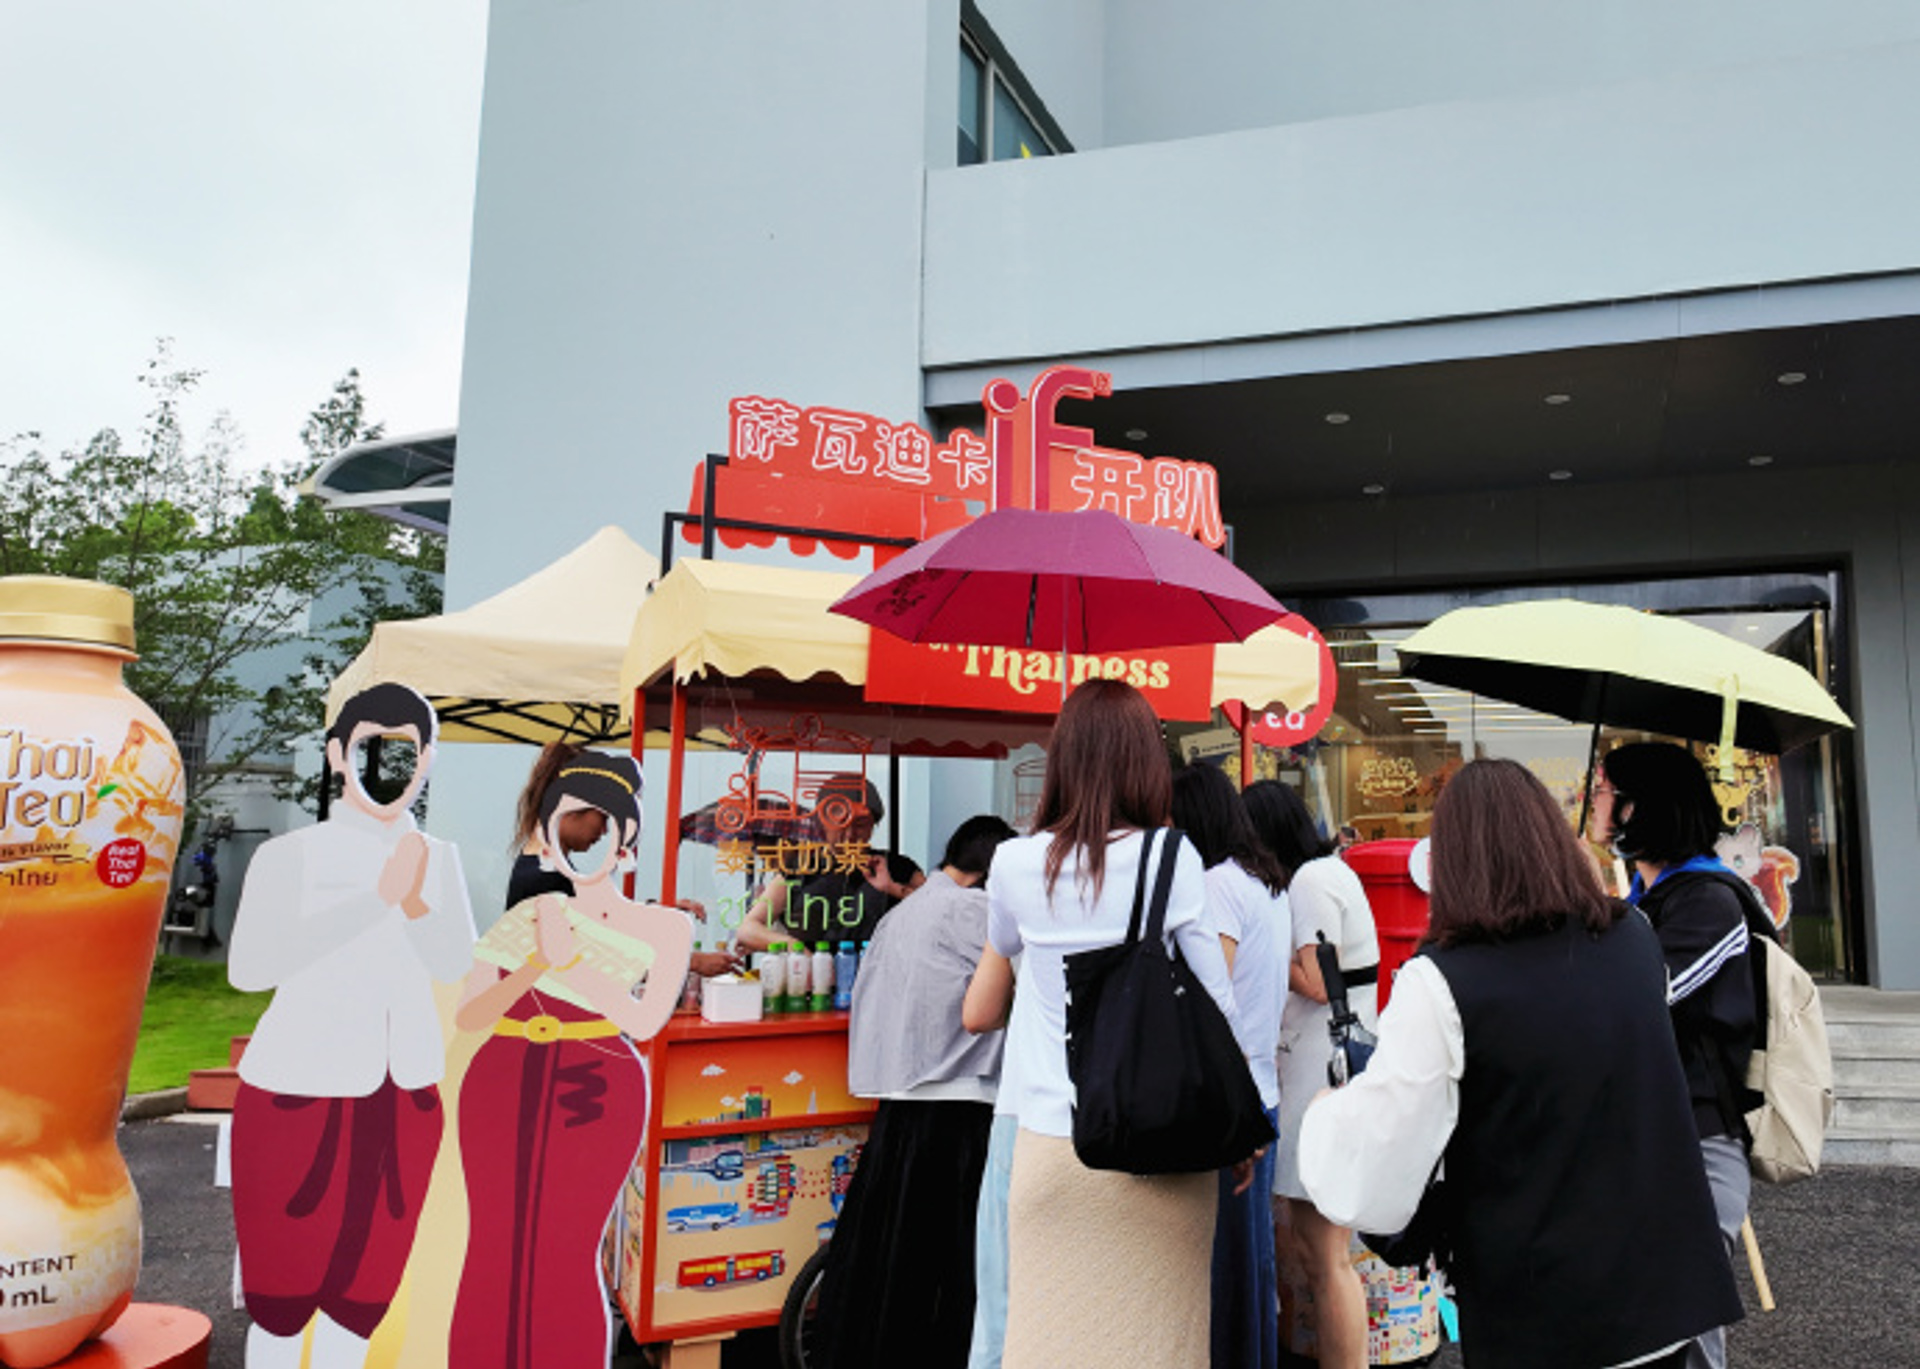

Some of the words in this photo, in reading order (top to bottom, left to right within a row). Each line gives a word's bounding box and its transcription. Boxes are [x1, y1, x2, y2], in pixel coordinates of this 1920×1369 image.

[736, 400, 991, 489] 萨瓦迪卡
[716, 838, 872, 875] 泰式奶茶
